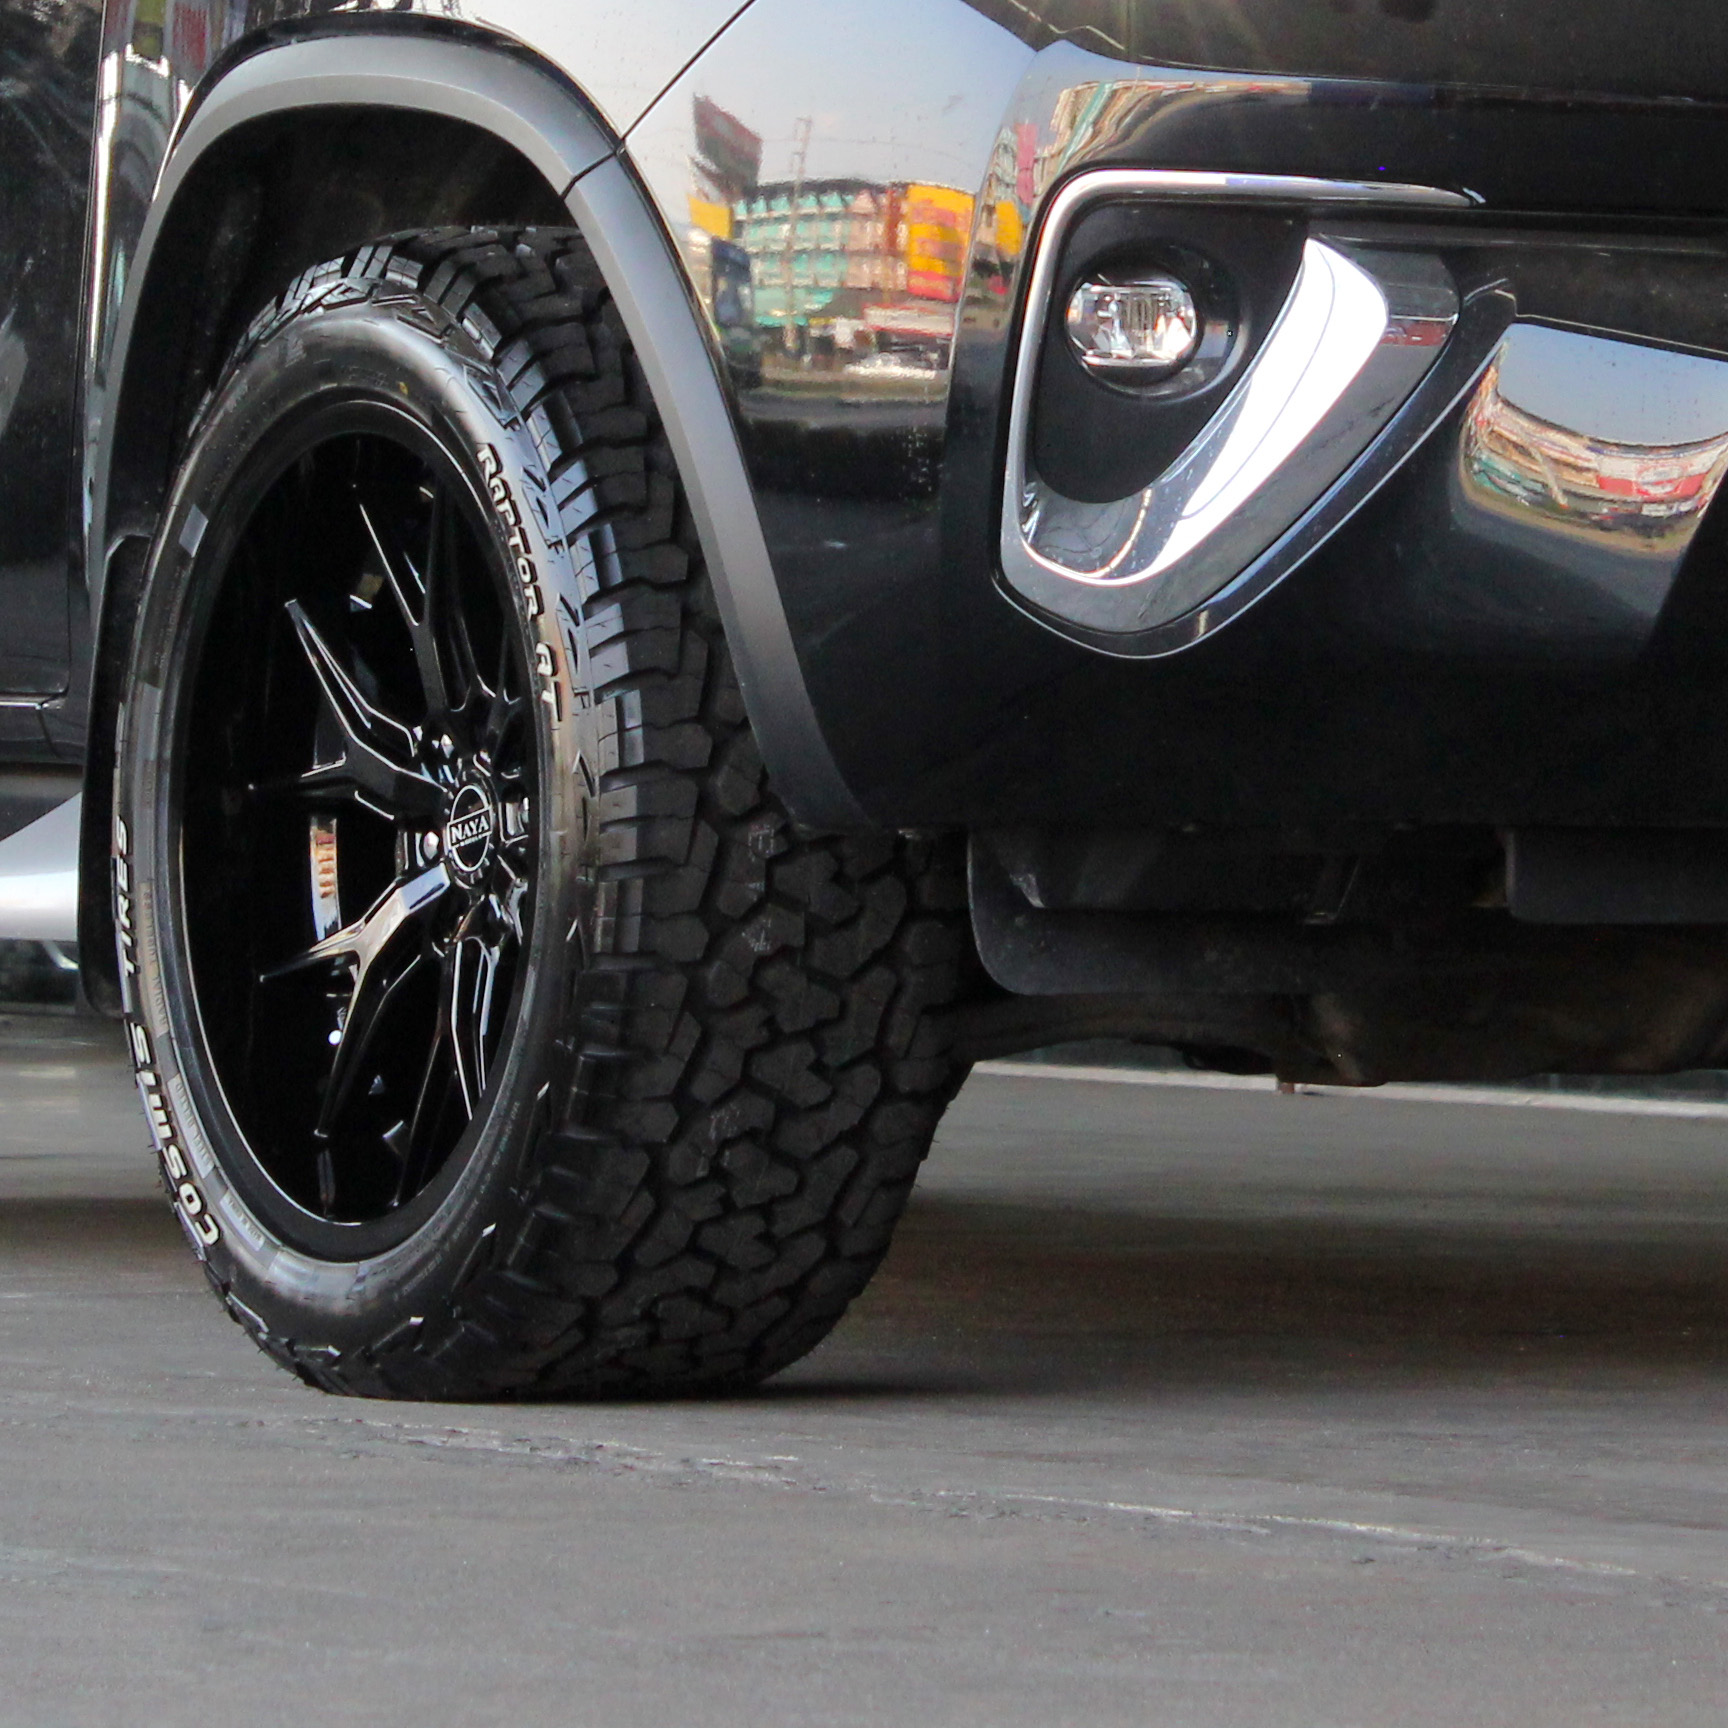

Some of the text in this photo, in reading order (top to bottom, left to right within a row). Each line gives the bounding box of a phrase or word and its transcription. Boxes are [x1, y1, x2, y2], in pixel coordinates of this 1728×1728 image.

[476, 443, 554, 731] RAPTOR AT
[451, 815, 490, 843] NAYA
[115, 813, 221, 1247] COSMIS TIRES
